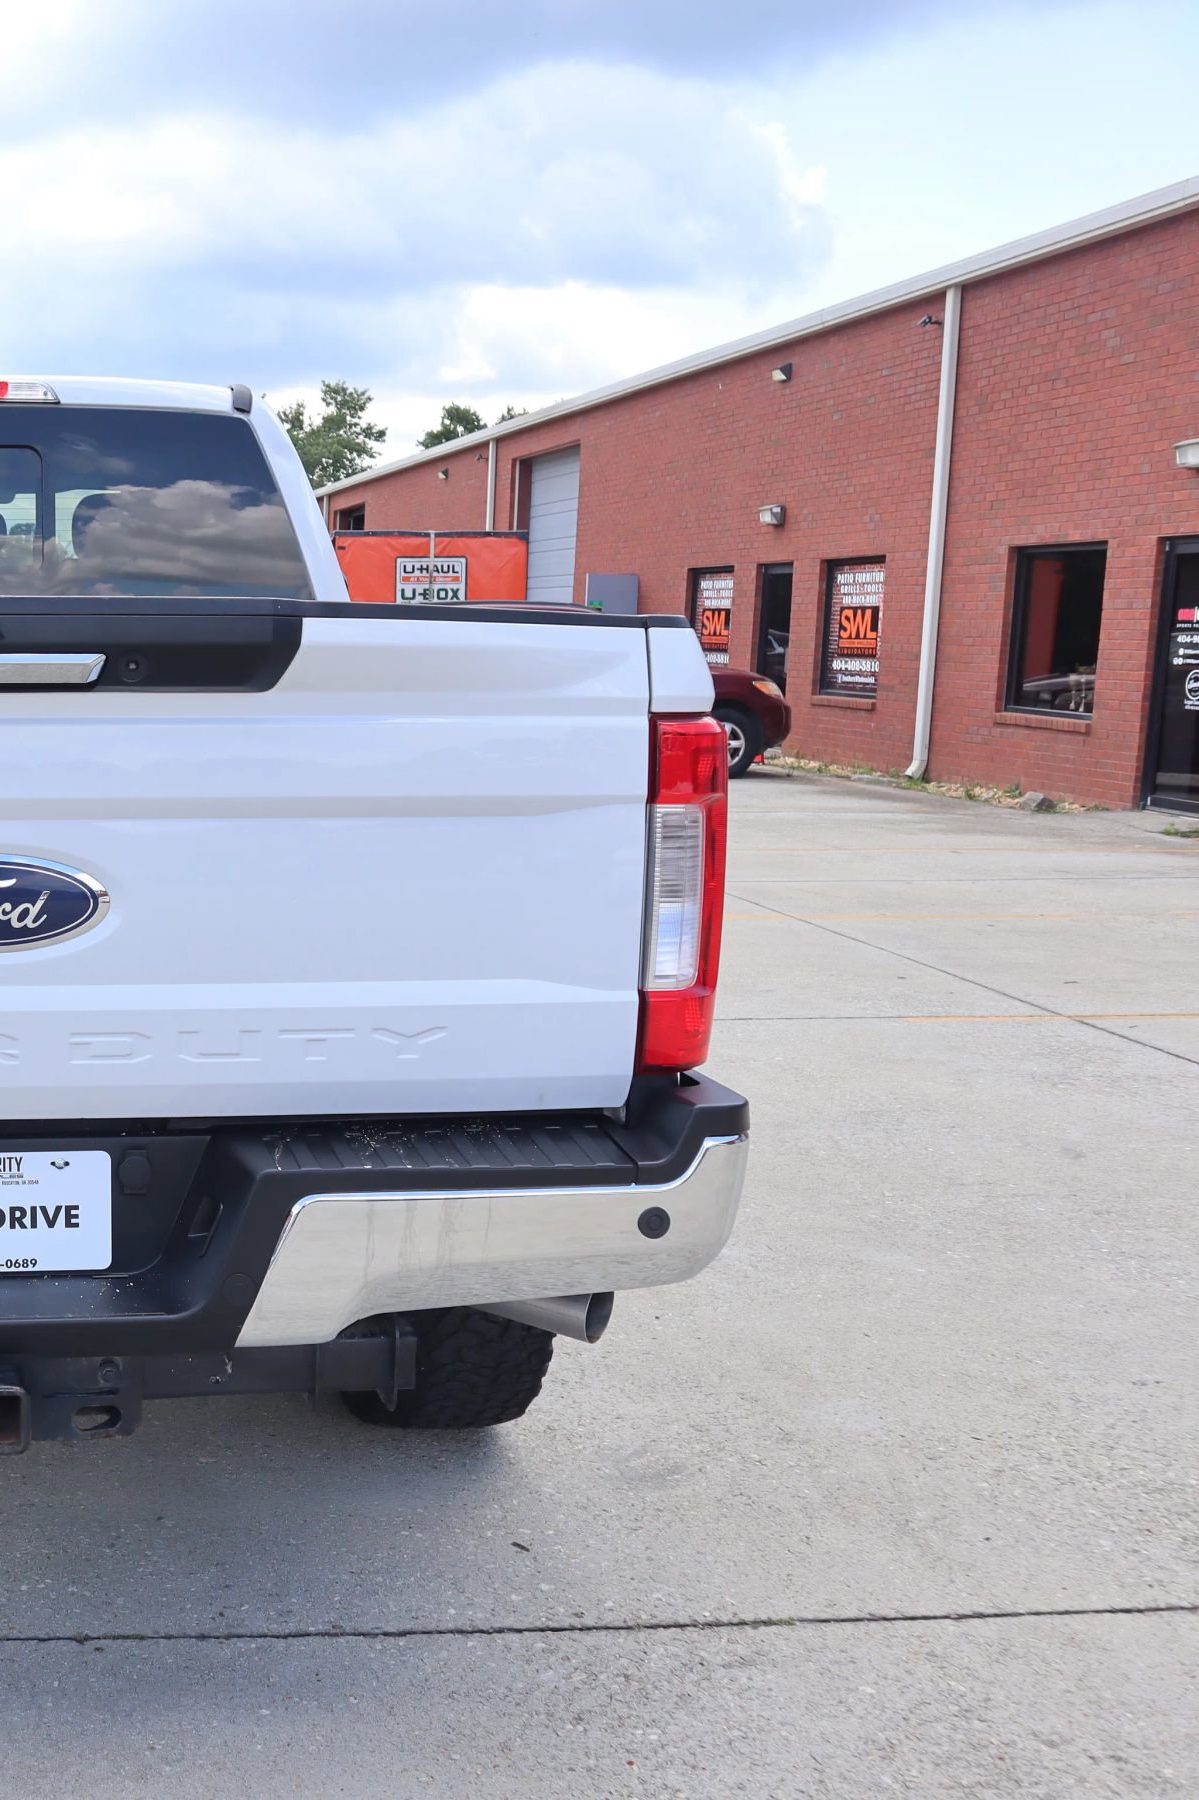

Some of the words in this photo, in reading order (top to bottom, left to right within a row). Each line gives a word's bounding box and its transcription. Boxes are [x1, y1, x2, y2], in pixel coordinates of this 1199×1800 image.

[403, 564, 460, 574] U-HAUL
[837, 573, 854, 585] PATIO
[855, 571, 885, 583] FURNITUR
[401, 588, 461, 601] U-BOX
[702, 610, 729, 636] SWL
[840, 608, 877, 639] SWL
[832, 659, 880, 672] 404-402-5810
[69, 1026, 448, 1064] DUTY
